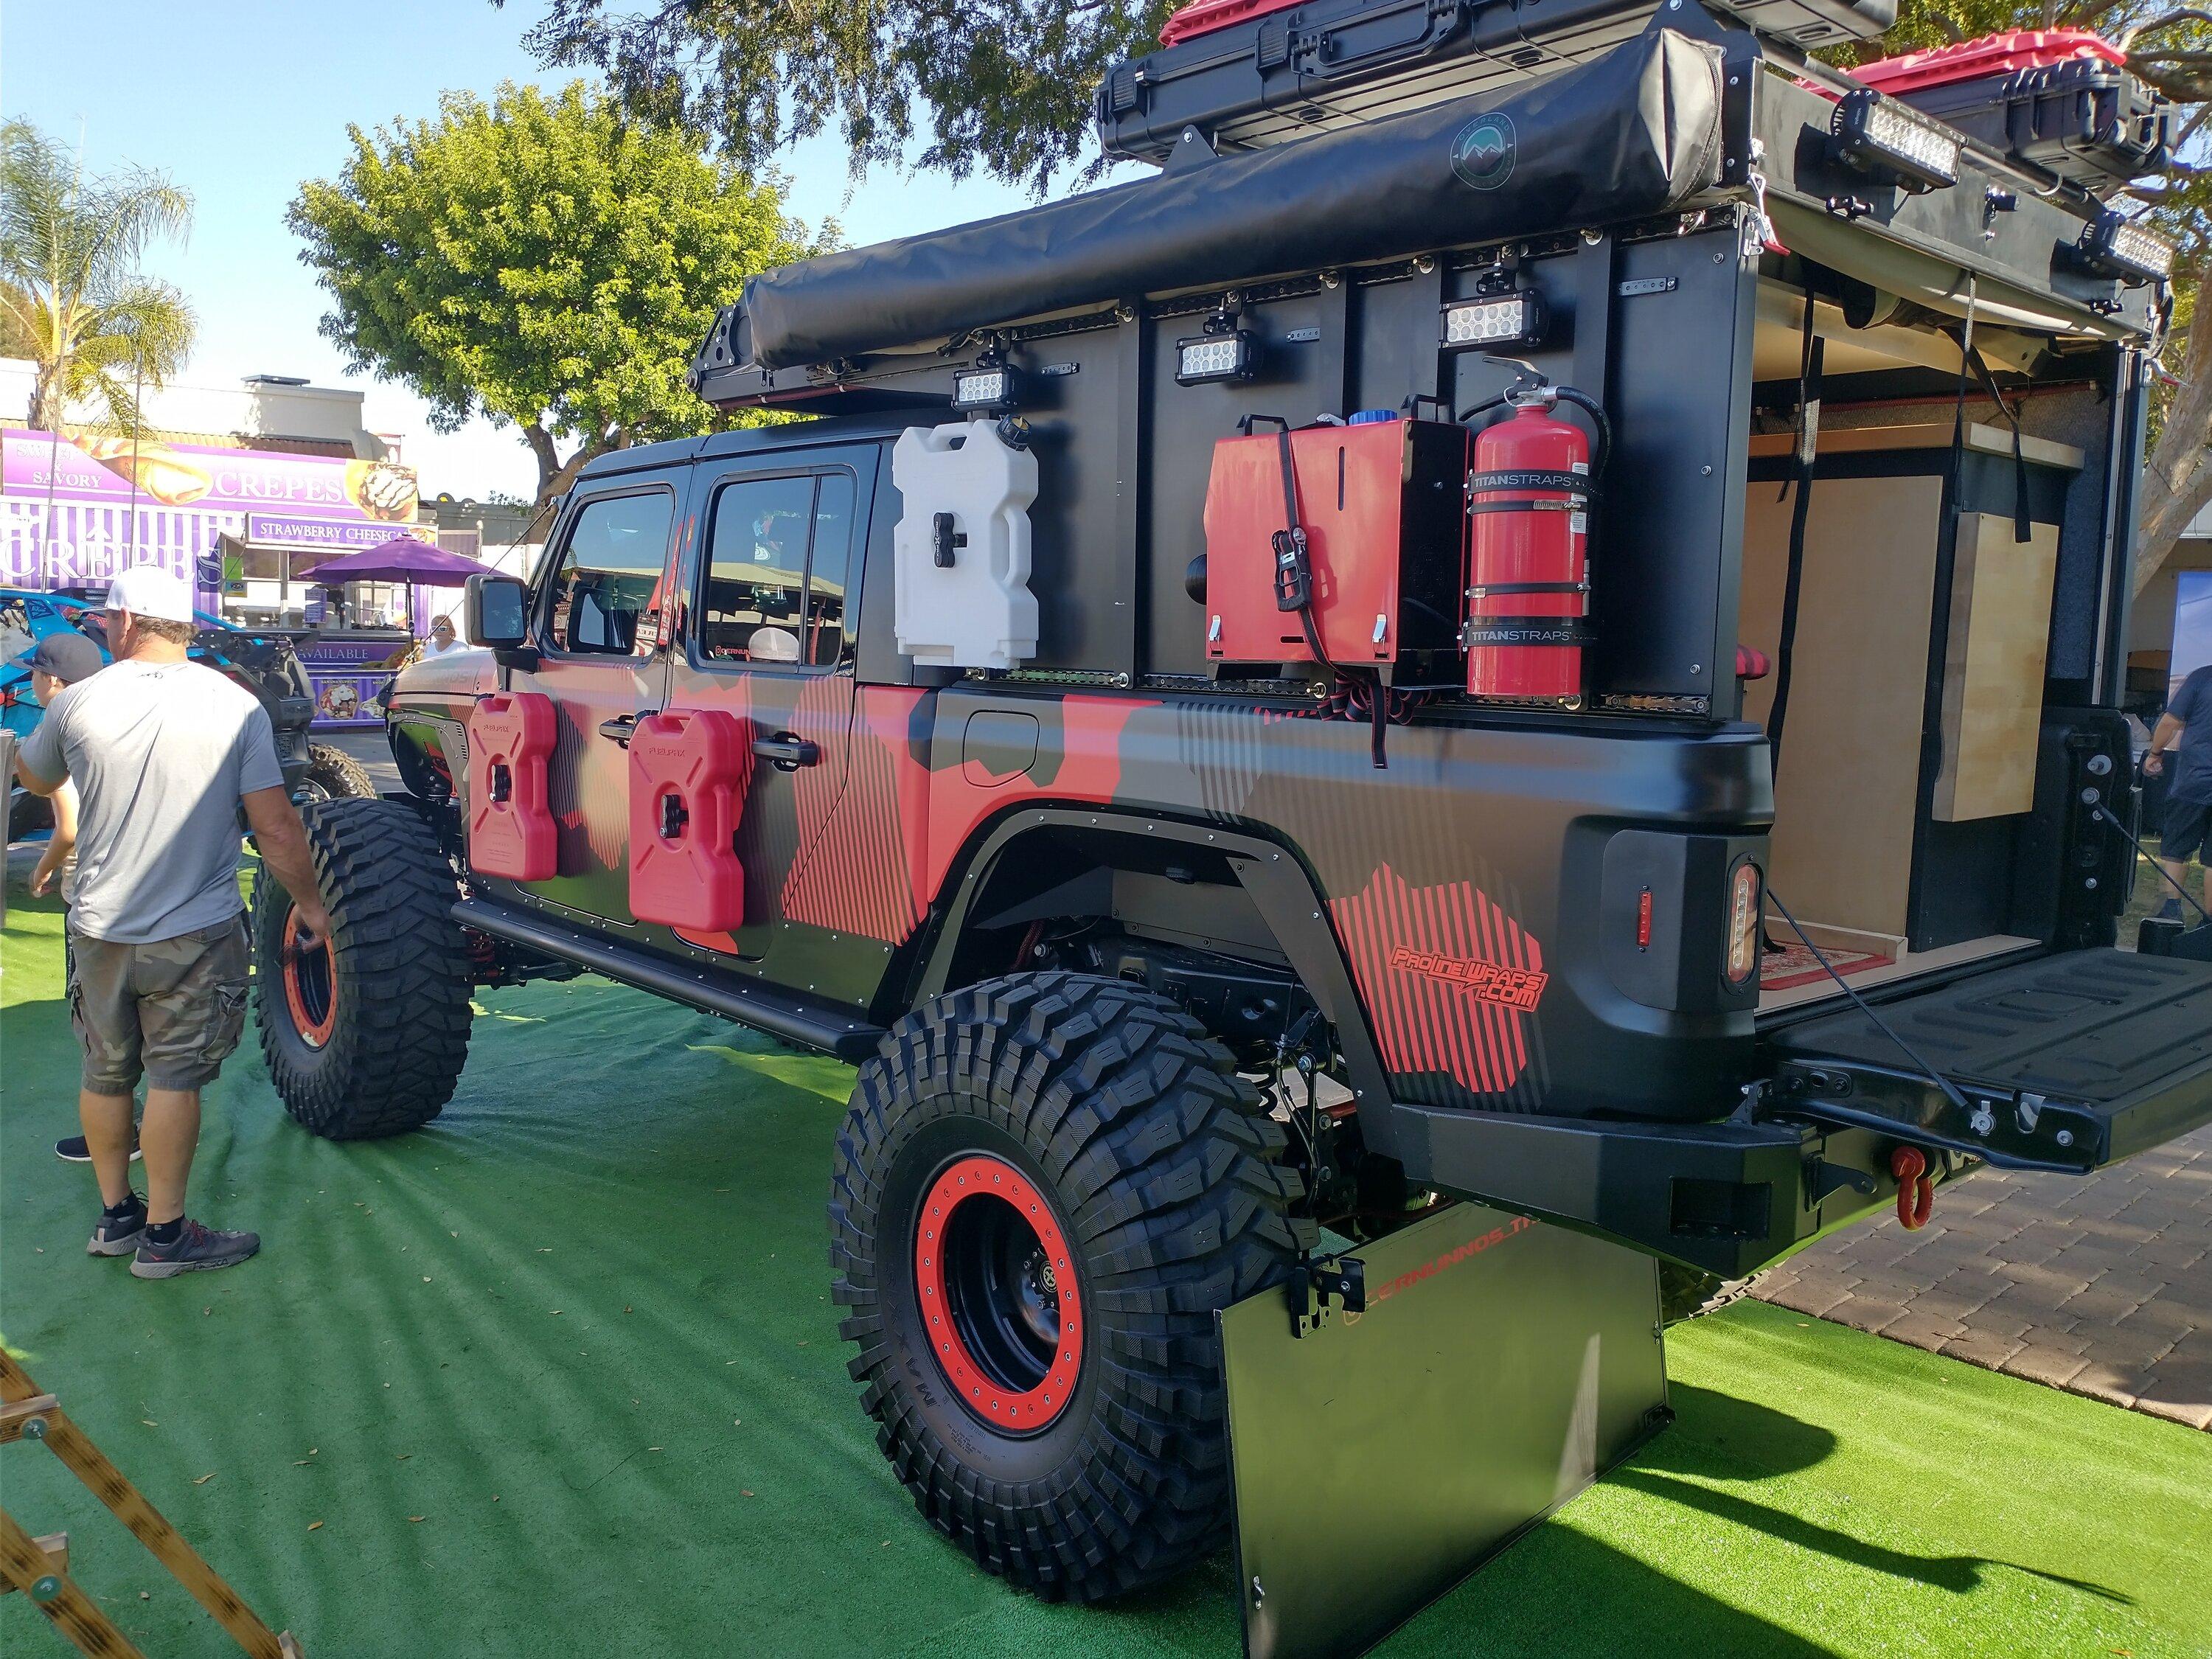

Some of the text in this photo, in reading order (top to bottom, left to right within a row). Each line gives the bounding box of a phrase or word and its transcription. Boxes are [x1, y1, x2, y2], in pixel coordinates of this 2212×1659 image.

[1458, 117, 1509, 140] OVERLAND
[32, 471, 102, 488] SAVORY
[215, 471, 344, 504] CREPES
[1474, 474, 1572, 488] TITANSTRAPS
[260, 522, 408, 542] STRAWBERRY CHEESECA
[1472, 630, 1571, 641] TITANSTRAPS
[297, 648, 369, 659] AVAILABLE
[648, 747, 685, 757] FUELPAX
[1480, 981, 1537, 1006] .COM
